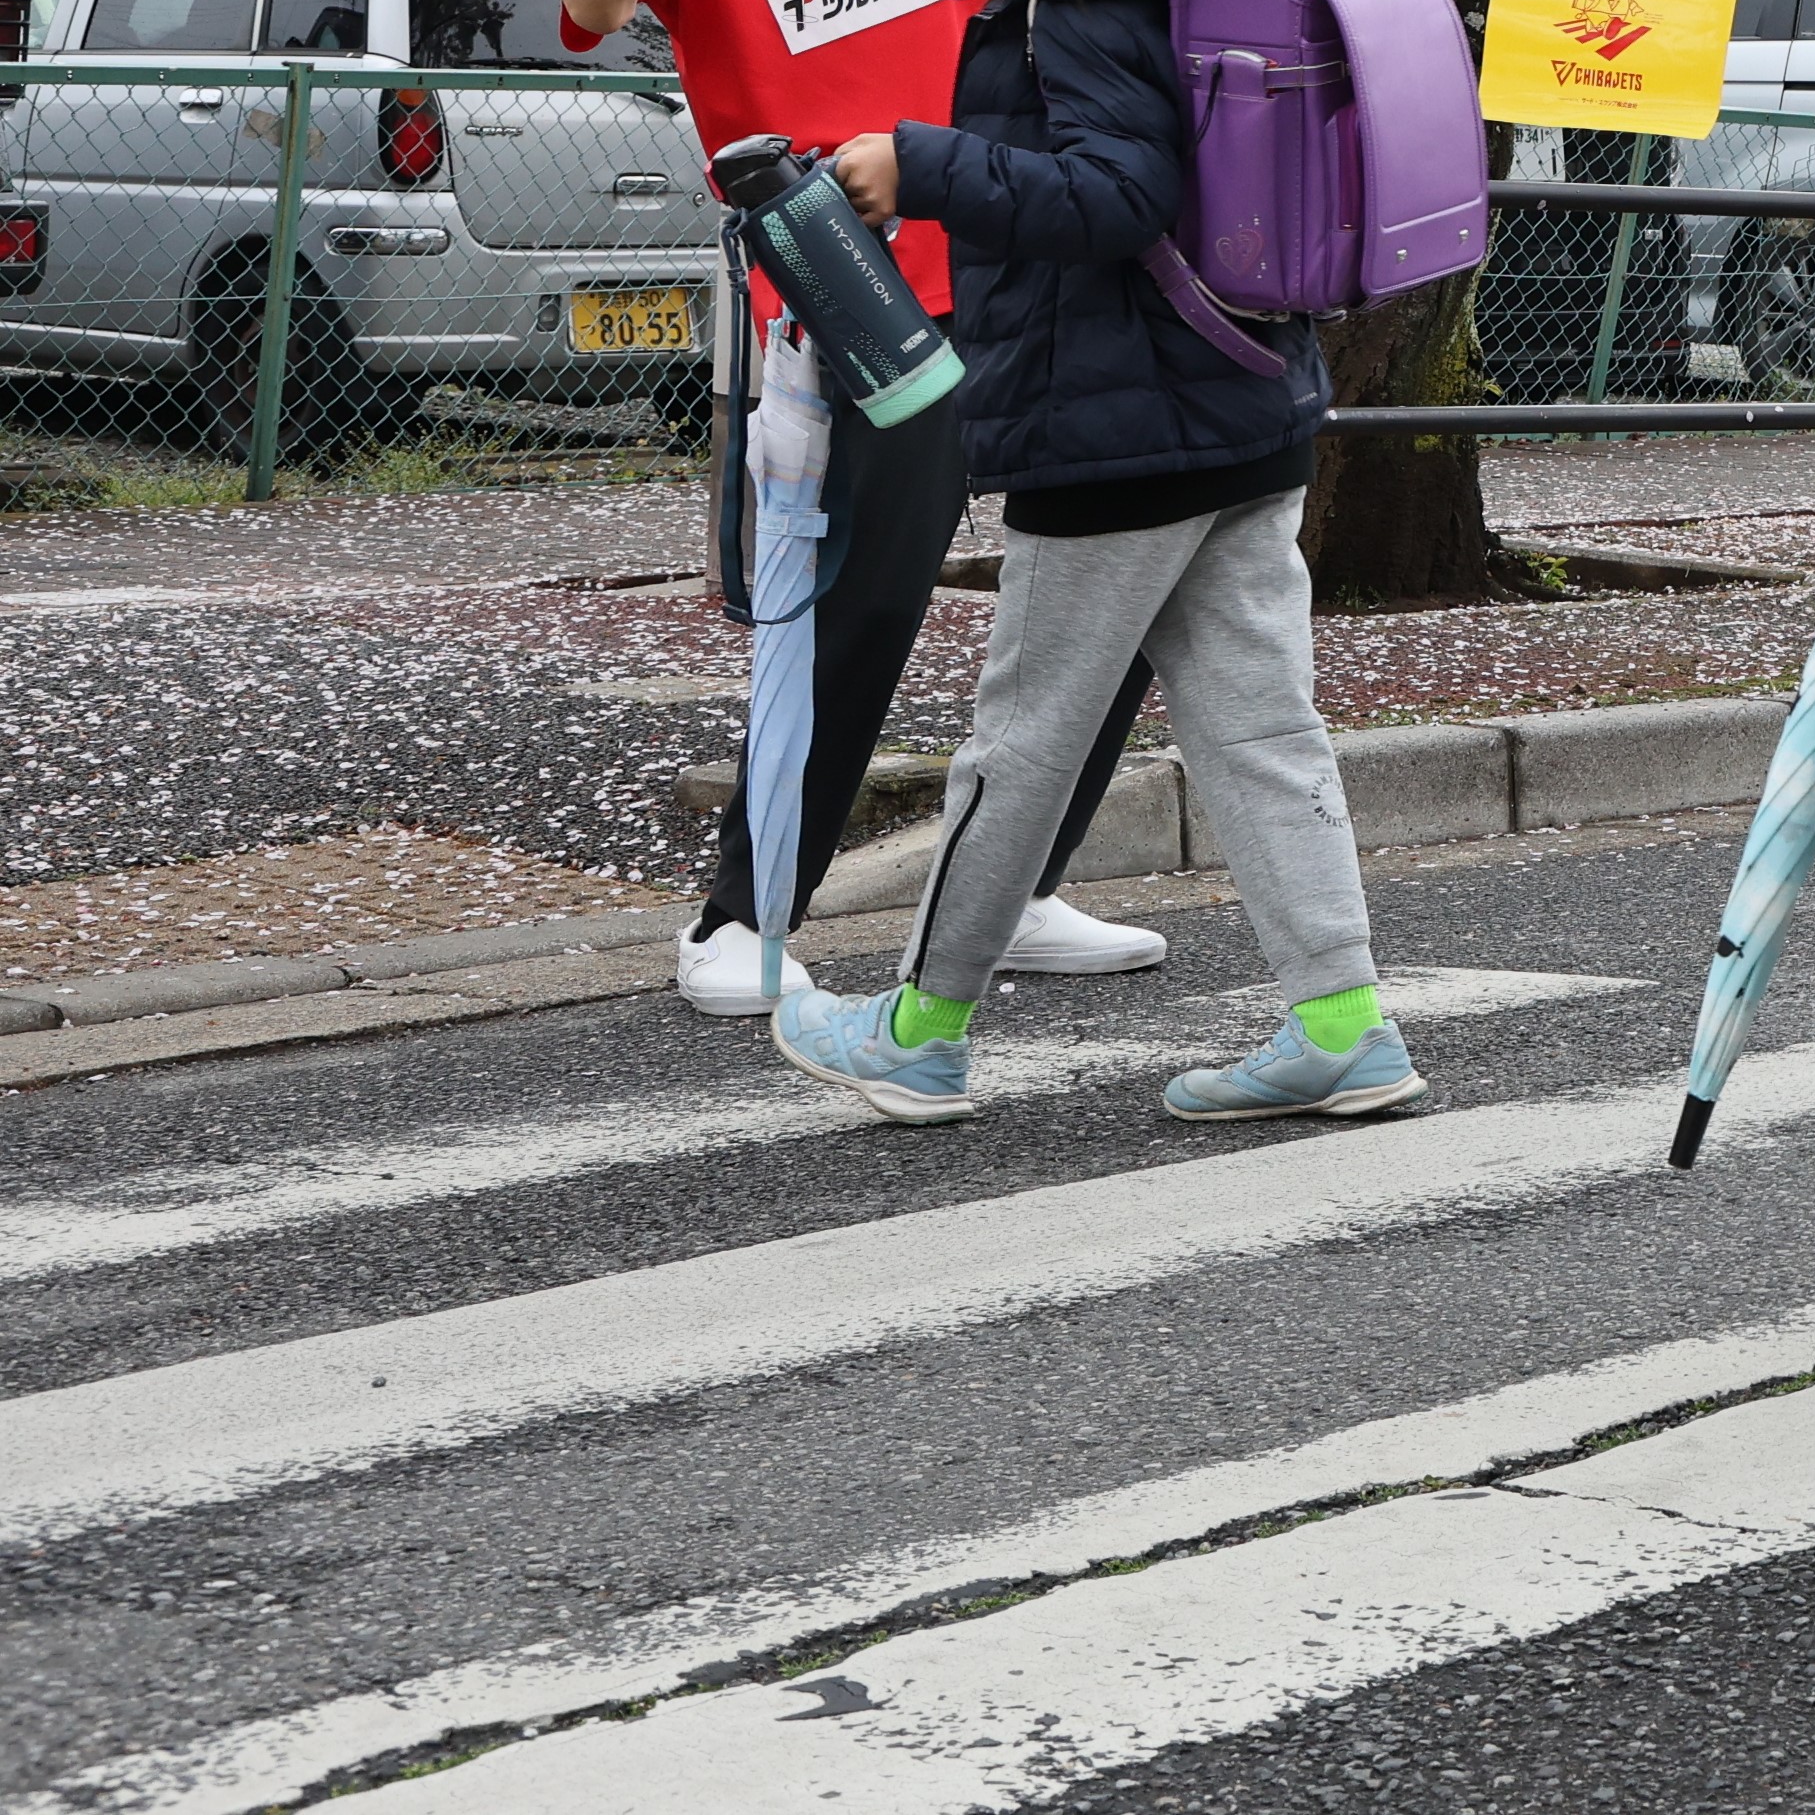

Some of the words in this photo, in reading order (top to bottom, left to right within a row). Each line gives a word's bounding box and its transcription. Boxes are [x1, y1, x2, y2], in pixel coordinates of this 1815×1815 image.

[1574, 67, 1643, 92] CHIBAJETS
[827, 218, 894, 306] HYDRATION
[600, 312, 683, 346] 80-55
[899, 328, 930, 354] THERMOS
